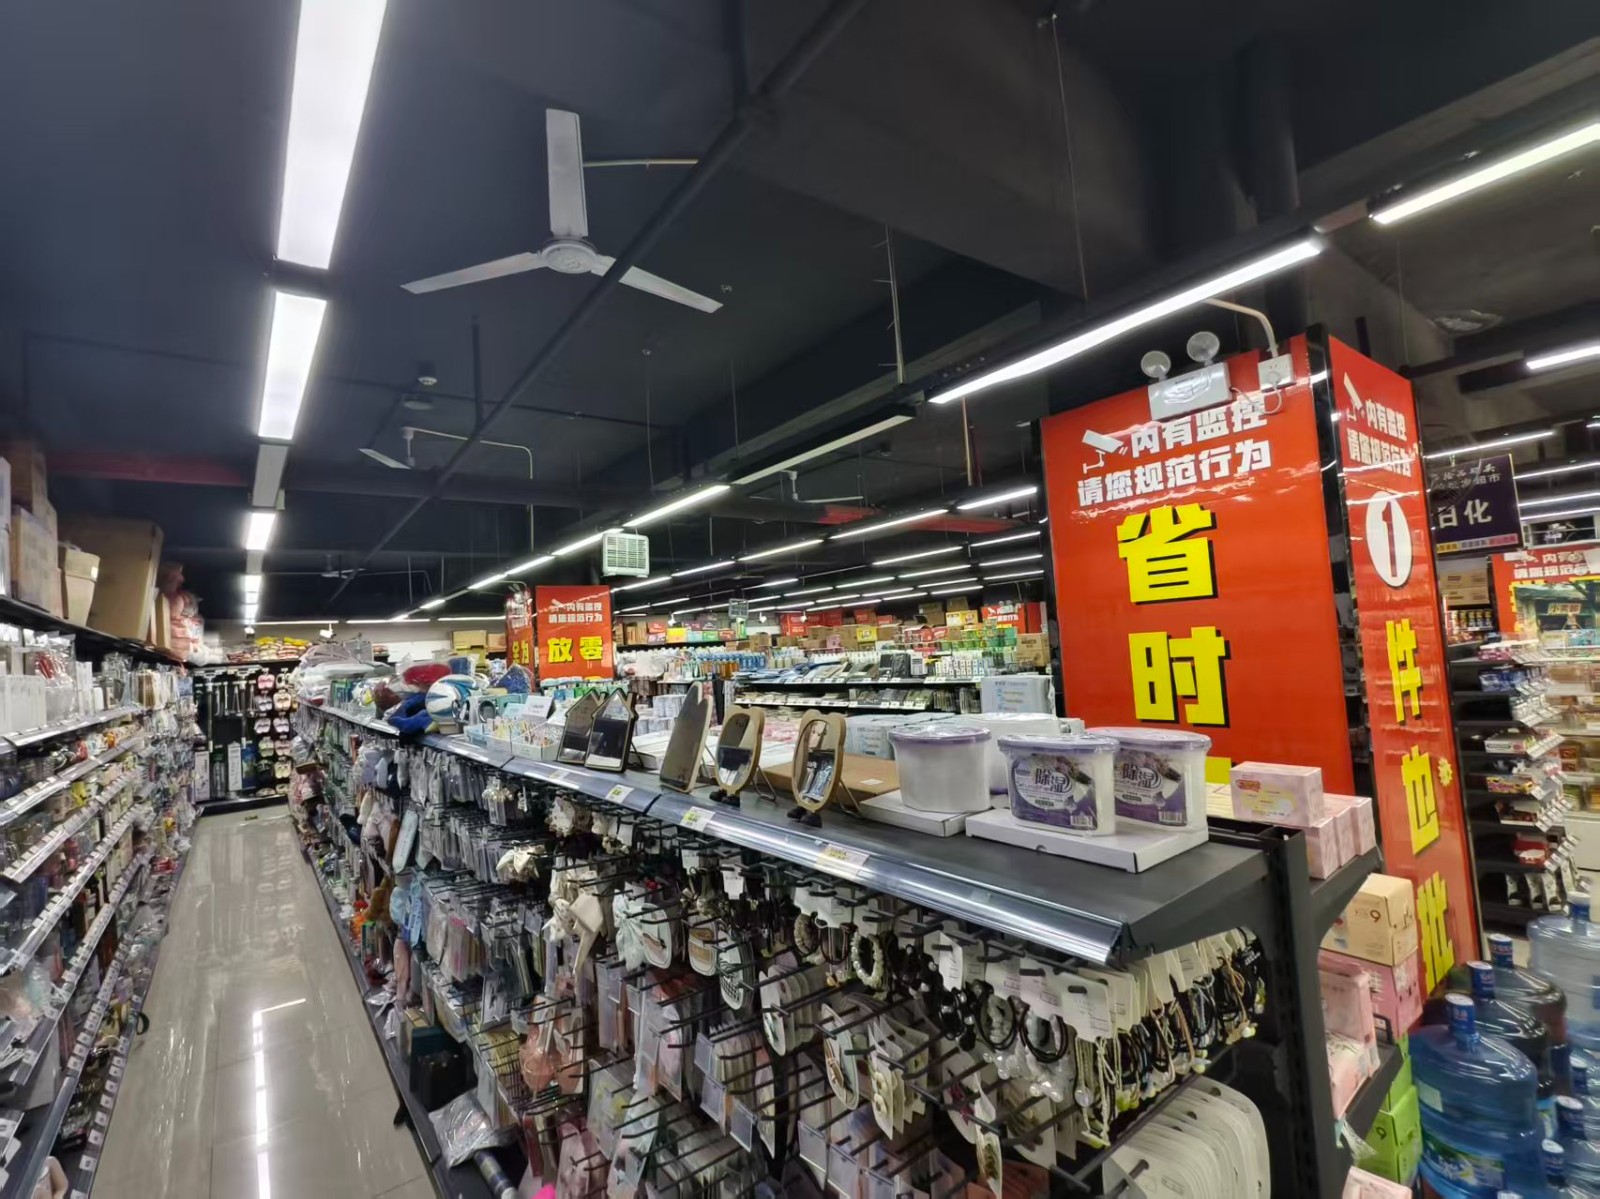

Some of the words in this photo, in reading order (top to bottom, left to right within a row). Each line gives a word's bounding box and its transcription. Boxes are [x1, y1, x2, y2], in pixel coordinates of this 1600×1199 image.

[1131, 393, 1268, 458] 内有监控
[1365, 398, 1408, 442] 内有监控
[1077, 437, 1272, 507] 请您规范行为
[1116, 502, 1231, 783] 省时
